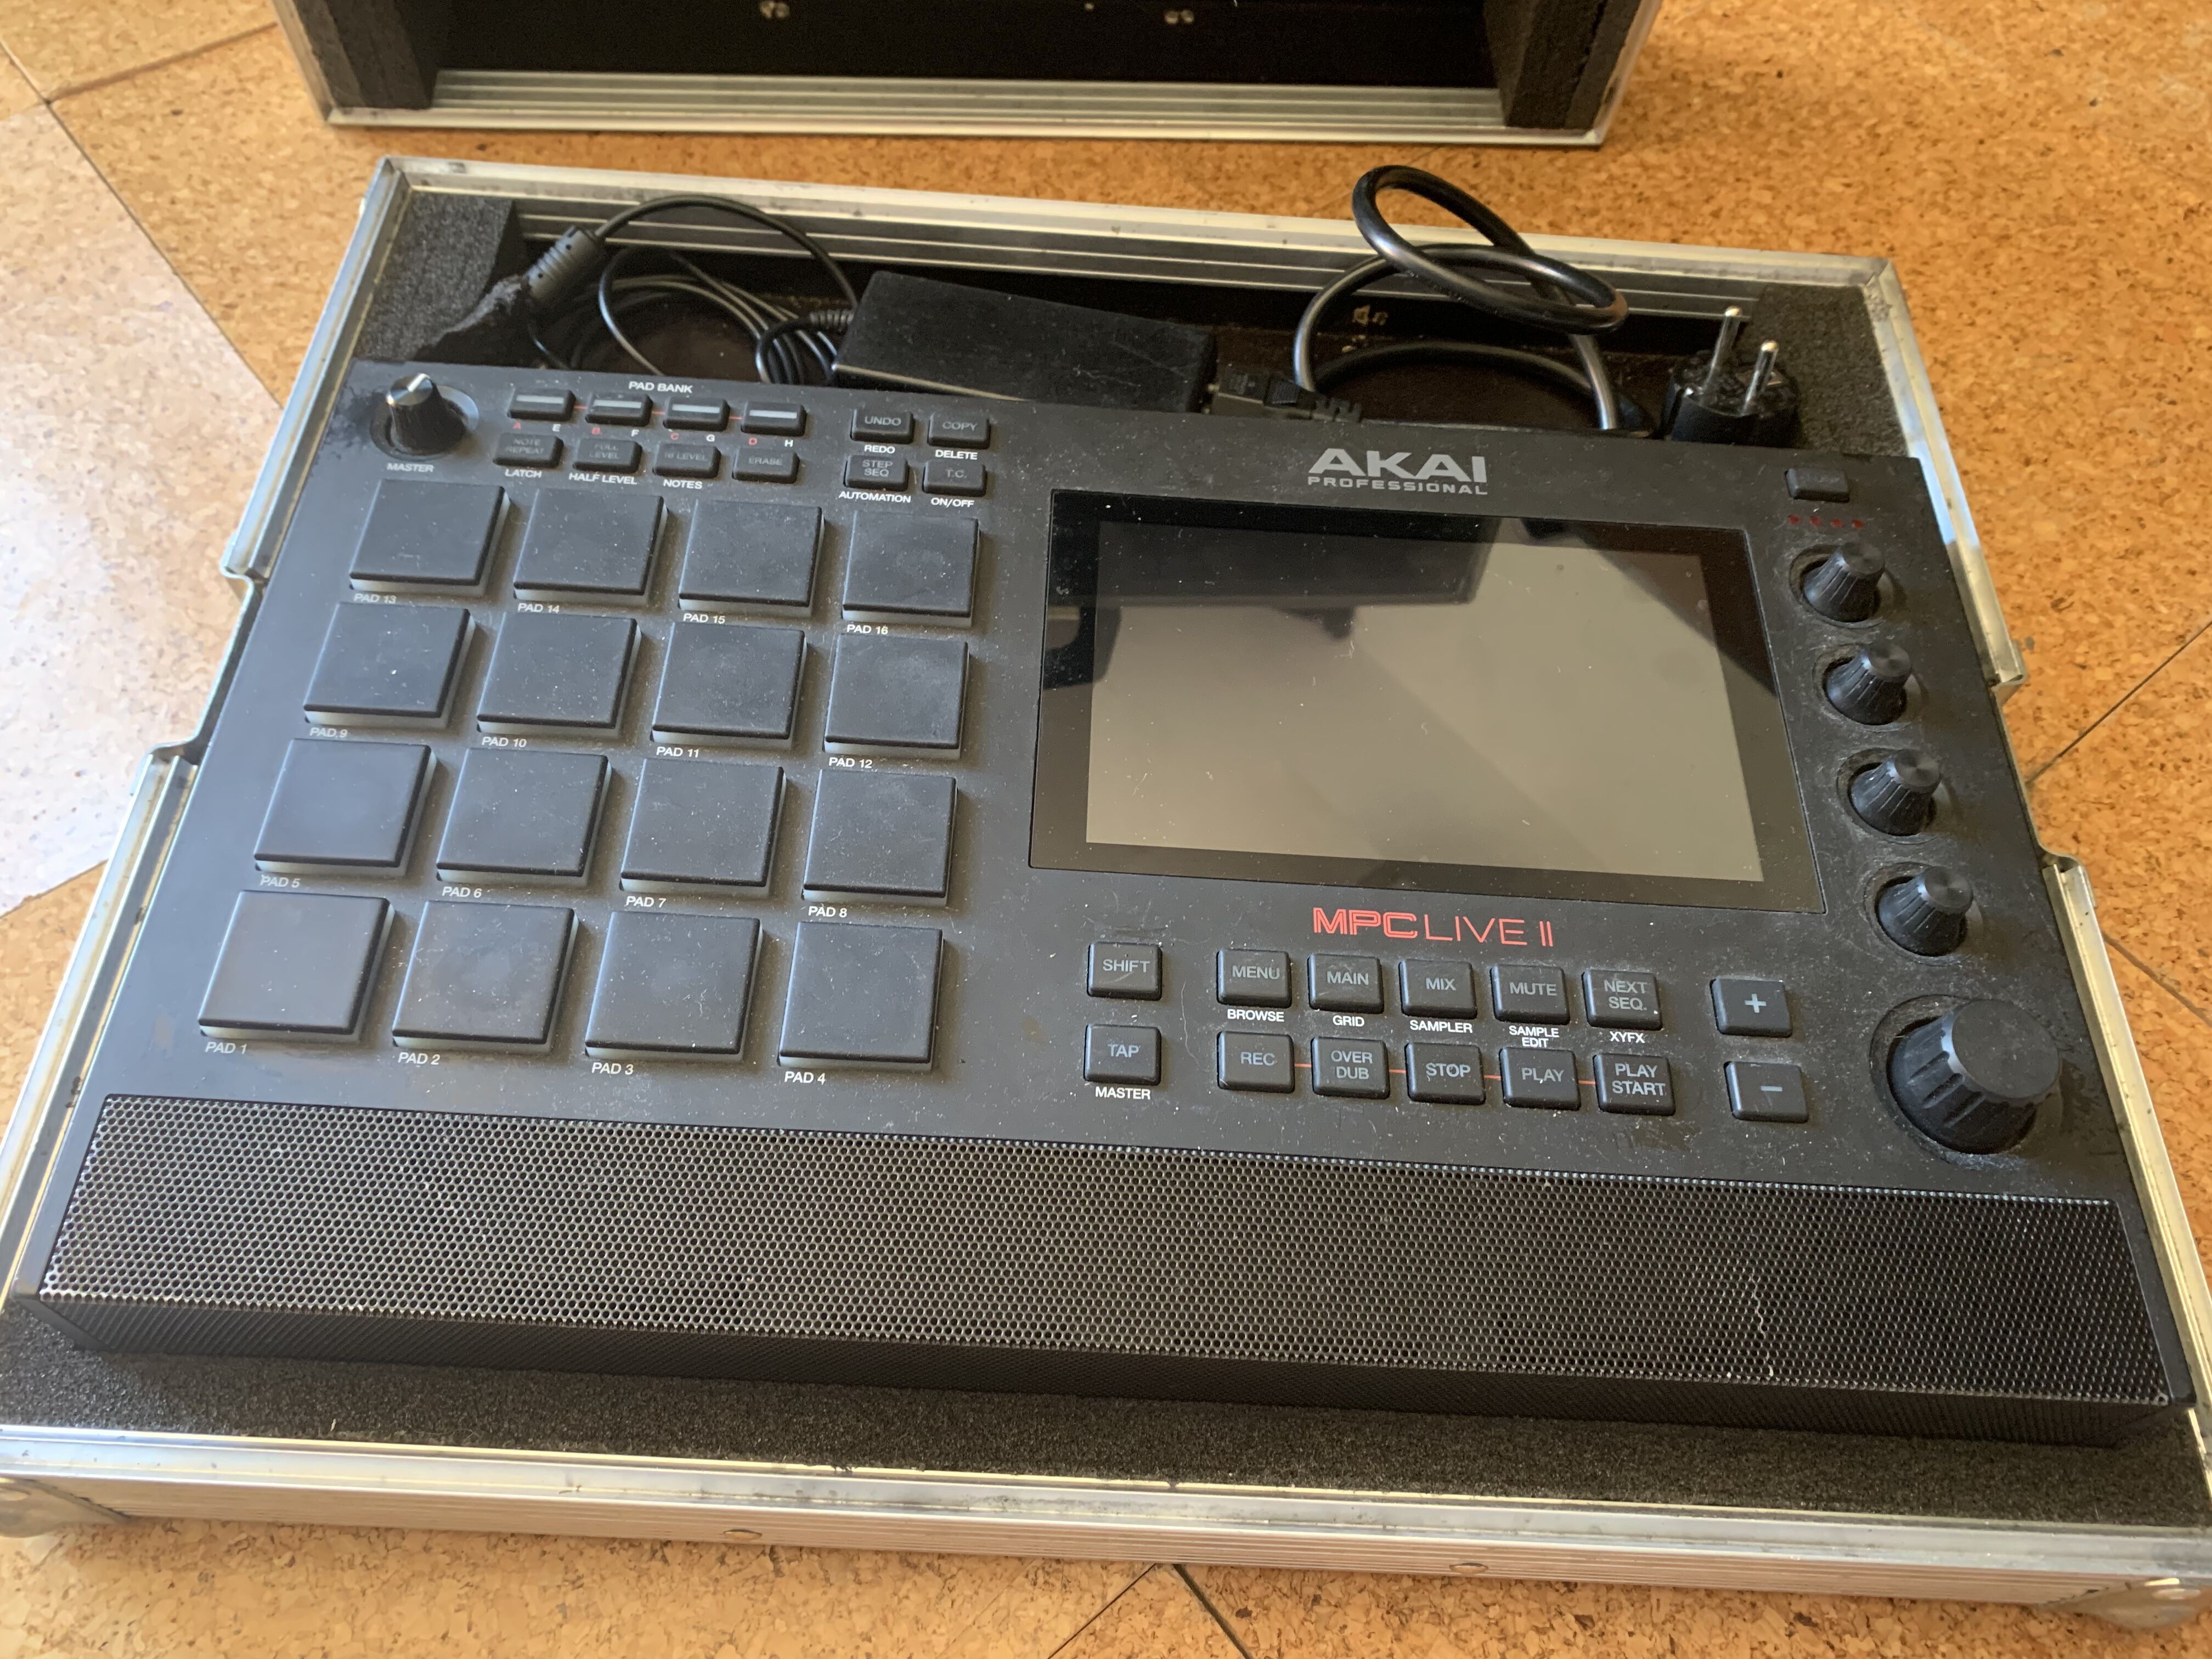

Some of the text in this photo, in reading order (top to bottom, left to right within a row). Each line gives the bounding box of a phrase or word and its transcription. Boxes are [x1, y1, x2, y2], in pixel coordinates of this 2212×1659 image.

[629, 381, 693, 393] PAD BANK
[865, 416, 901, 426] UNDO
[942, 421, 978, 431] COPY
[589, 451, 619, 459] LEVEL
[864, 444, 895, 454] REDO
[935, 450, 978, 460] DELETE
[676, 453, 708, 461] LEVEL
[749, 458, 783, 466] ERASE
[386, 462, 434, 472] MASTER
[862, 460, 893, 468] STEP
[1308, 448, 1487, 483] AKAI
[505, 469, 541, 478] LATCH
[568, 472, 637, 485] HALF LEVEL
[864, 469, 889, 477] SEQ
[946, 469, 967, 478] T.C.
[663, 479, 703, 489] NOTES
[1307, 476, 1488, 495] PROFESSIONAL
[838, 490, 911, 504] AUTOMATION
[930, 497, 974, 507] ON/OFF
[353, 593, 397, 603] PAD 13
[518, 603, 560, 613] PAD 14
[683, 613, 725, 624] PAD 15
[847, 624, 888, 635] PAD 16
[310, 727, 348, 738] PAD 9
[482, 736, 527, 747] PAD 10
[656, 747, 699, 757] PAD 11
[828, 757, 873, 768] PAD 12
[260, 876, 301, 888] PAD 5
[442, 887, 482, 898] PAD 6
[625, 896, 667, 907] PAD 7
[808, 906, 847, 917] PAD 8
[1313, 907, 1553, 947] MPC LIVE II
[1103, 959, 1150, 973] SHIFT
[1232, 966, 1280, 979] MENU
[1327, 971, 1369, 985] MAIN
[1426, 978, 1456, 991] MIX
[1510, 982, 1558, 996] MUTE
[1604, 980, 1647, 994] NEXT
[1609, 997, 1647, 1011] SEQ.
[1227, 1009, 1284, 1022] BROWSE
[1333, 1015, 1364, 1026] GRID
[1410, 1019, 1472, 1033] SAMPLER
[1509, 1025, 1559, 1037] SAMPLE
[1522, 1037, 1549, 1048] EDIT
[1610, 1031, 1645, 1043] XYFX
[205, 1042, 247, 1054] PAD 1
[1108, 1043, 1139, 1058] TAP
[398, 1052, 441, 1065] PAD 2
[1240, 1052, 1276, 1066] REC
[1331, 1050, 1372, 1063] OVER
[591, 1062, 634, 1075] PAD 3
[1336, 1066, 1369, 1079] DUB
[1426, 1063, 1471, 1077] STOP
[1615, 1063, 1657, 1078] PLAY
[785, 1071, 826, 1085] PAD 4
[1522, 1068, 1564, 1082] PLAY
[1096, 1086, 1150, 1099] MASTER
[1612, 1080, 1666, 1096] START
